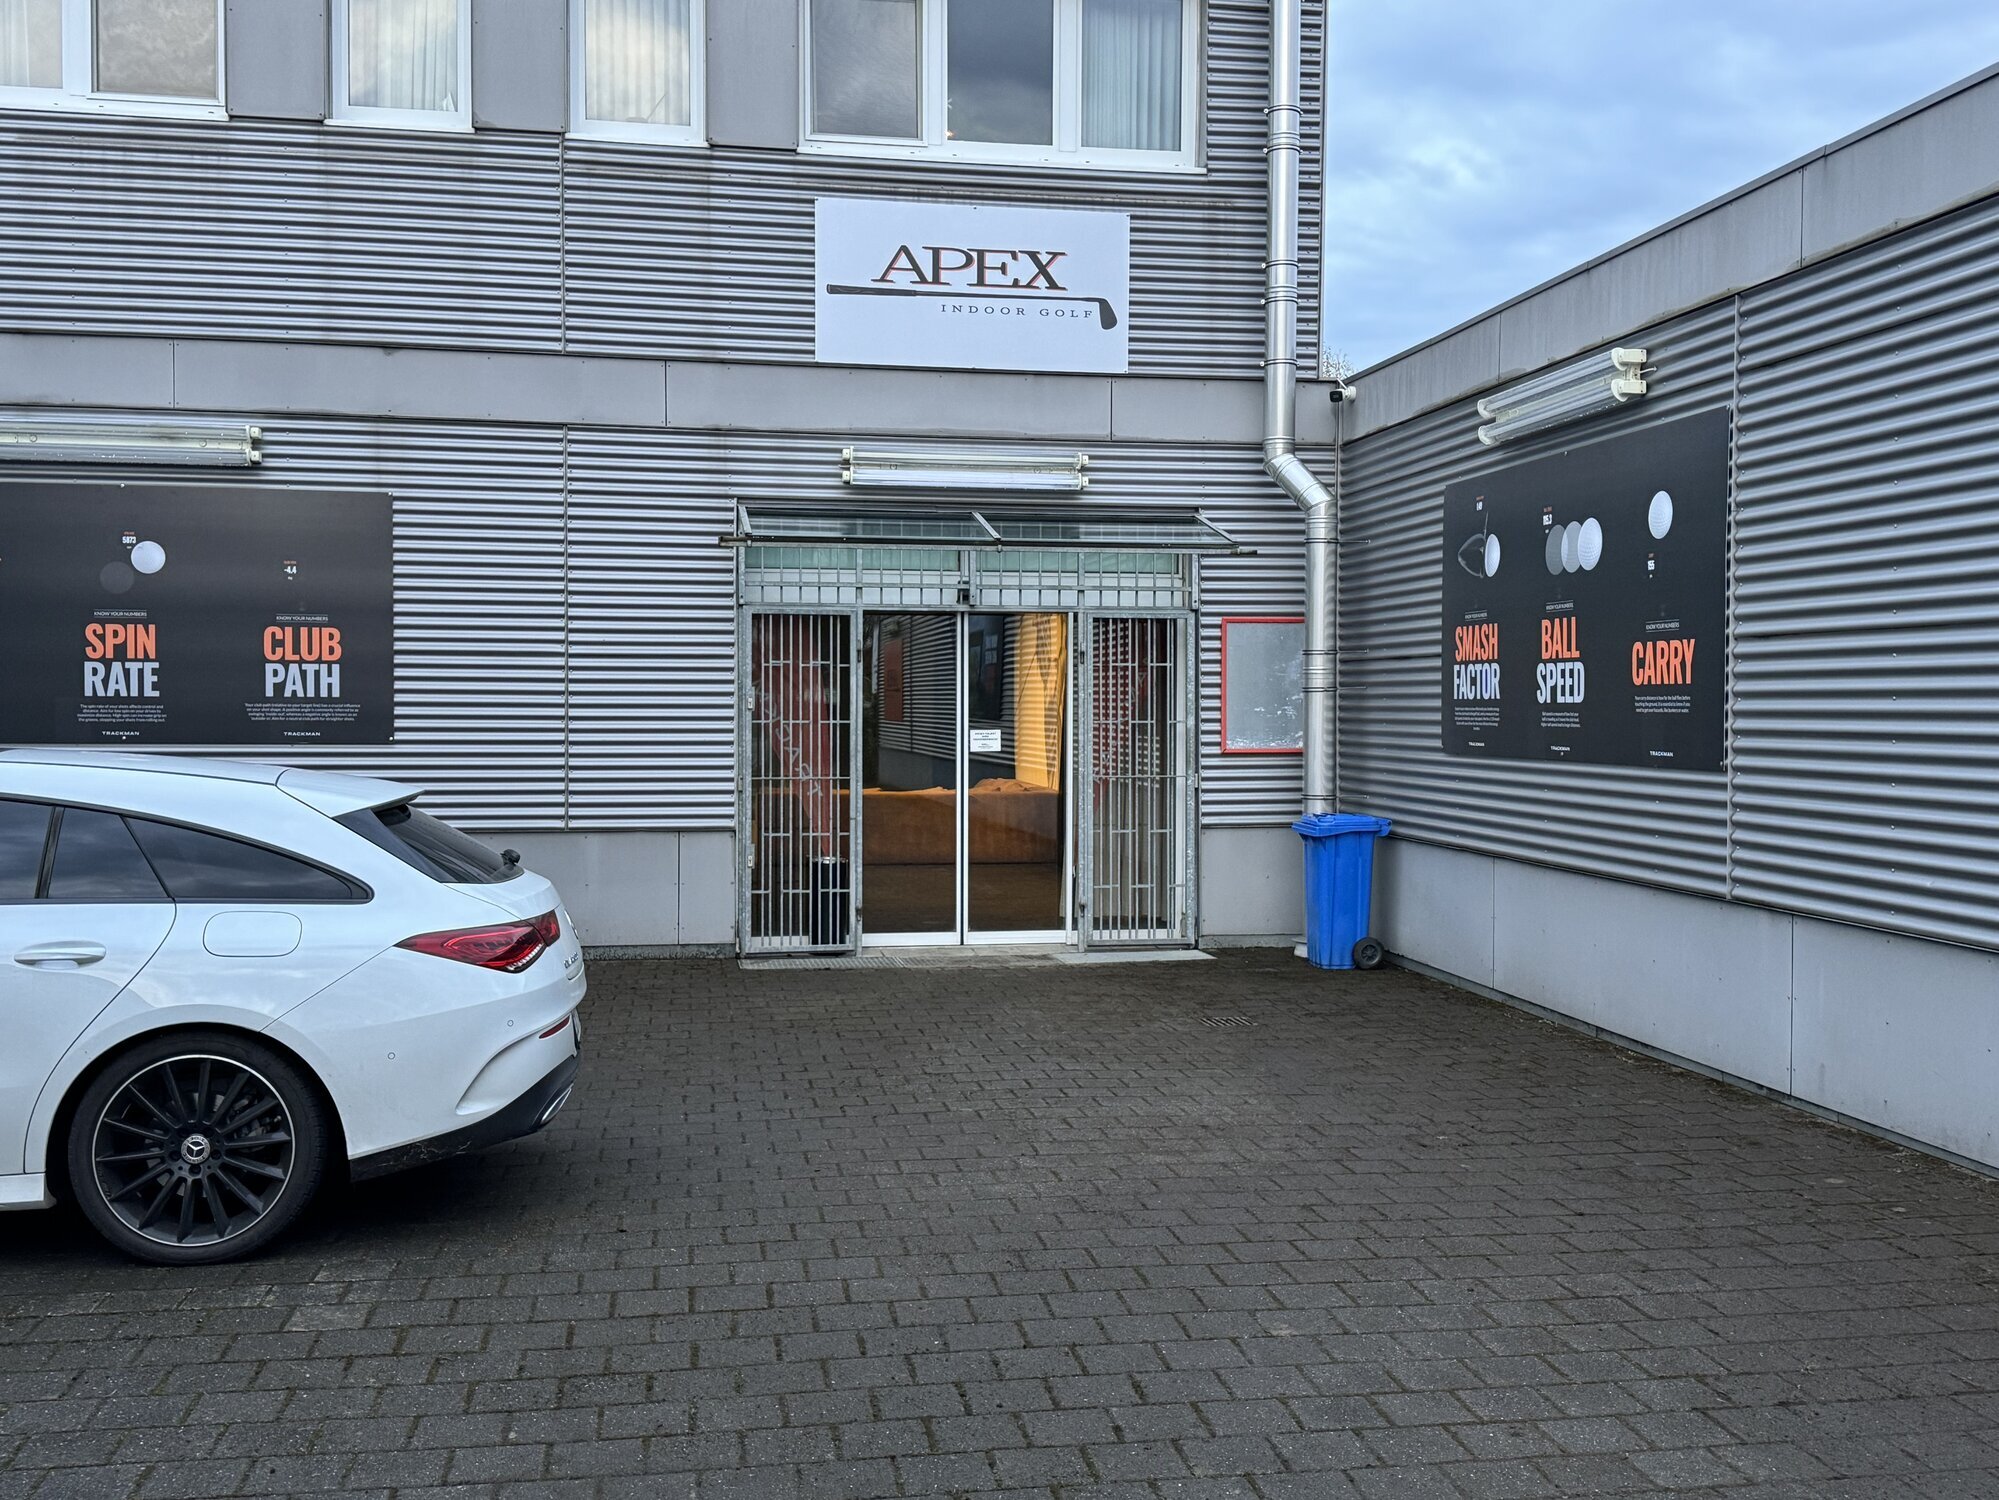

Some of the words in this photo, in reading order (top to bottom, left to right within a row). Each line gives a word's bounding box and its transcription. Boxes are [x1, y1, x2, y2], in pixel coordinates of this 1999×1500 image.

[870, 244, 1067, 291] APEX
[941, 304, 1026, 316] INDOOR
[1039, 308, 1093, 318] GOLF
[85, 623, 156, 659] SPIN
[263, 626, 342, 661] CLUB
[1455, 623, 1498, 662] SMASH
[1541, 616, 1580, 660] BALL
[84, 661, 160, 697] RATE
[265, 663, 340, 697] PATH
[1453, 662, 1500, 700] FACTOR
[1632, 638, 1696, 686] CARRY
[1536, 661, 1585, 704] SPEED
